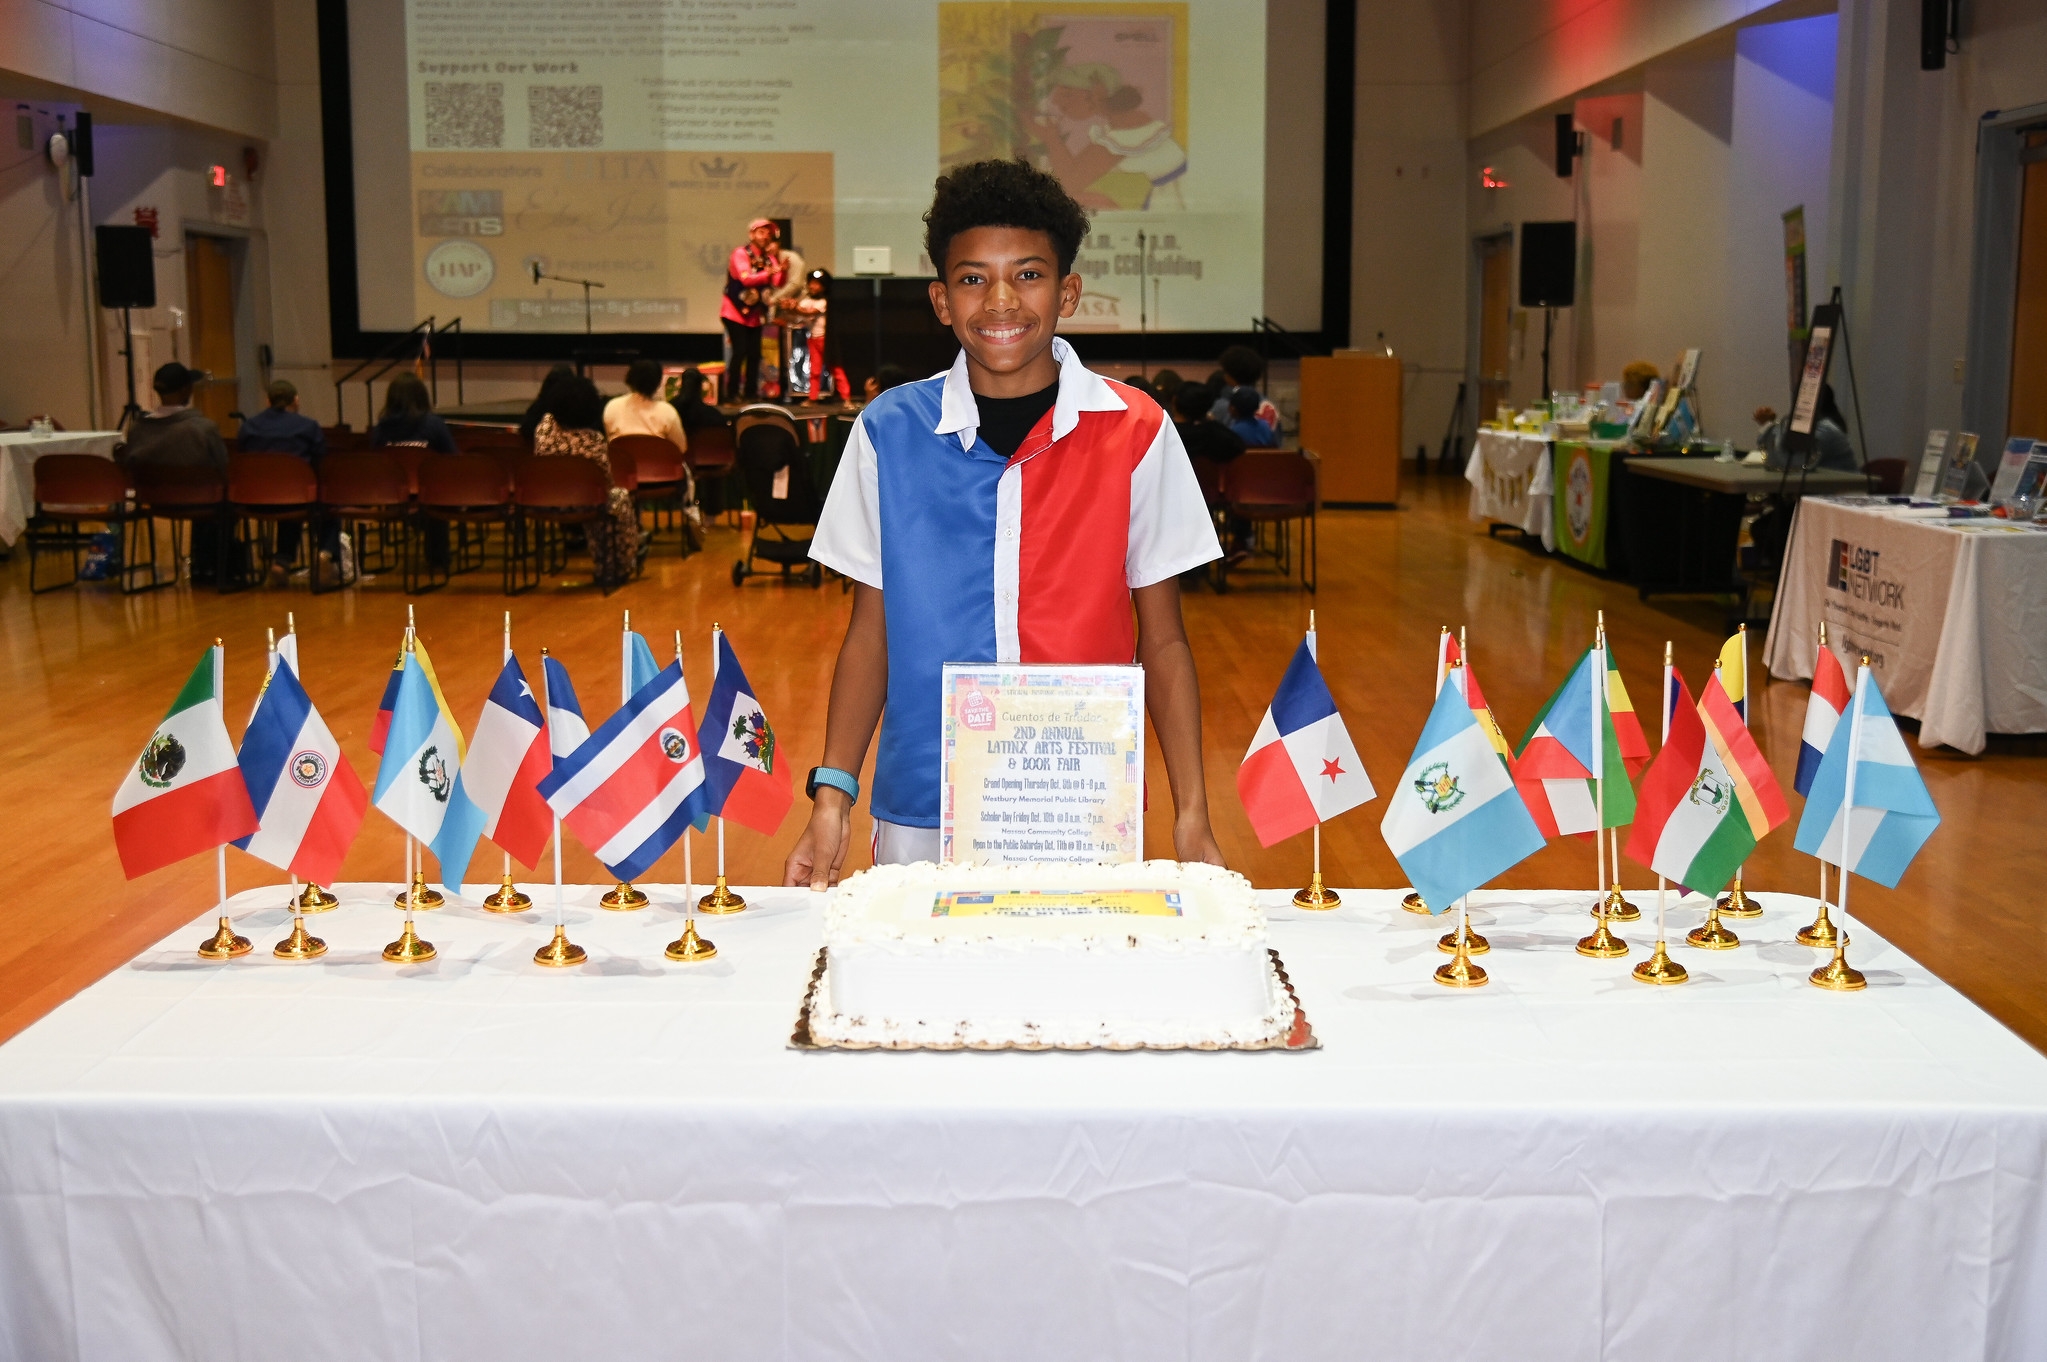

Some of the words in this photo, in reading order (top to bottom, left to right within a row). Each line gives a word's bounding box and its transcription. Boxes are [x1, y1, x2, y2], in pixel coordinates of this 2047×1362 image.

[417, 61, 490, 75] Support
[495, 61, 527, 73] Our
[532, 61, 580, 73] Work
[967, 712, 993, 724] DATE
[1001, 712, 1044, 722] Cuentos
[1047, 712, 1061, 722] de
[1013, 726, 1036, 739] 2ND
[1041, 726, 1084, 740] ANNUAL
[987, 741, 1028, 755] LATINX
[1034, 741, 1063, 755] ARTS
[1068, 741, 1117, 755] FESTIVAL
[1008, 758, 1017, 770] &
[1022, 757, 1051, 771] BOOK
[1057, 757, 1081, 771] FAIR
[983, 778, 1000, 789] Grand
[1002, 778, 1022, 791] Opening
[1024, 778, 1049, 791] Thursday
[983, 795, 1017, 803] Westbury
[1078, 796, 1105, 804] Library
[980, 811, 1001, 822] Scholar
[1002, 812, 1012, 824] Day
[1013, 812, 1030, 824] Friday
[1087, 812, 1092, 823] 2
[1067, 829, 1092, 837] College
[986, 840, 993, 849] to
[993, 839, 1002, 849] the
[1003, 839, 1019, 850] Public
[1020, 840, 1043, 852] Saturday
[1100, 841, 1105, 851] 4
